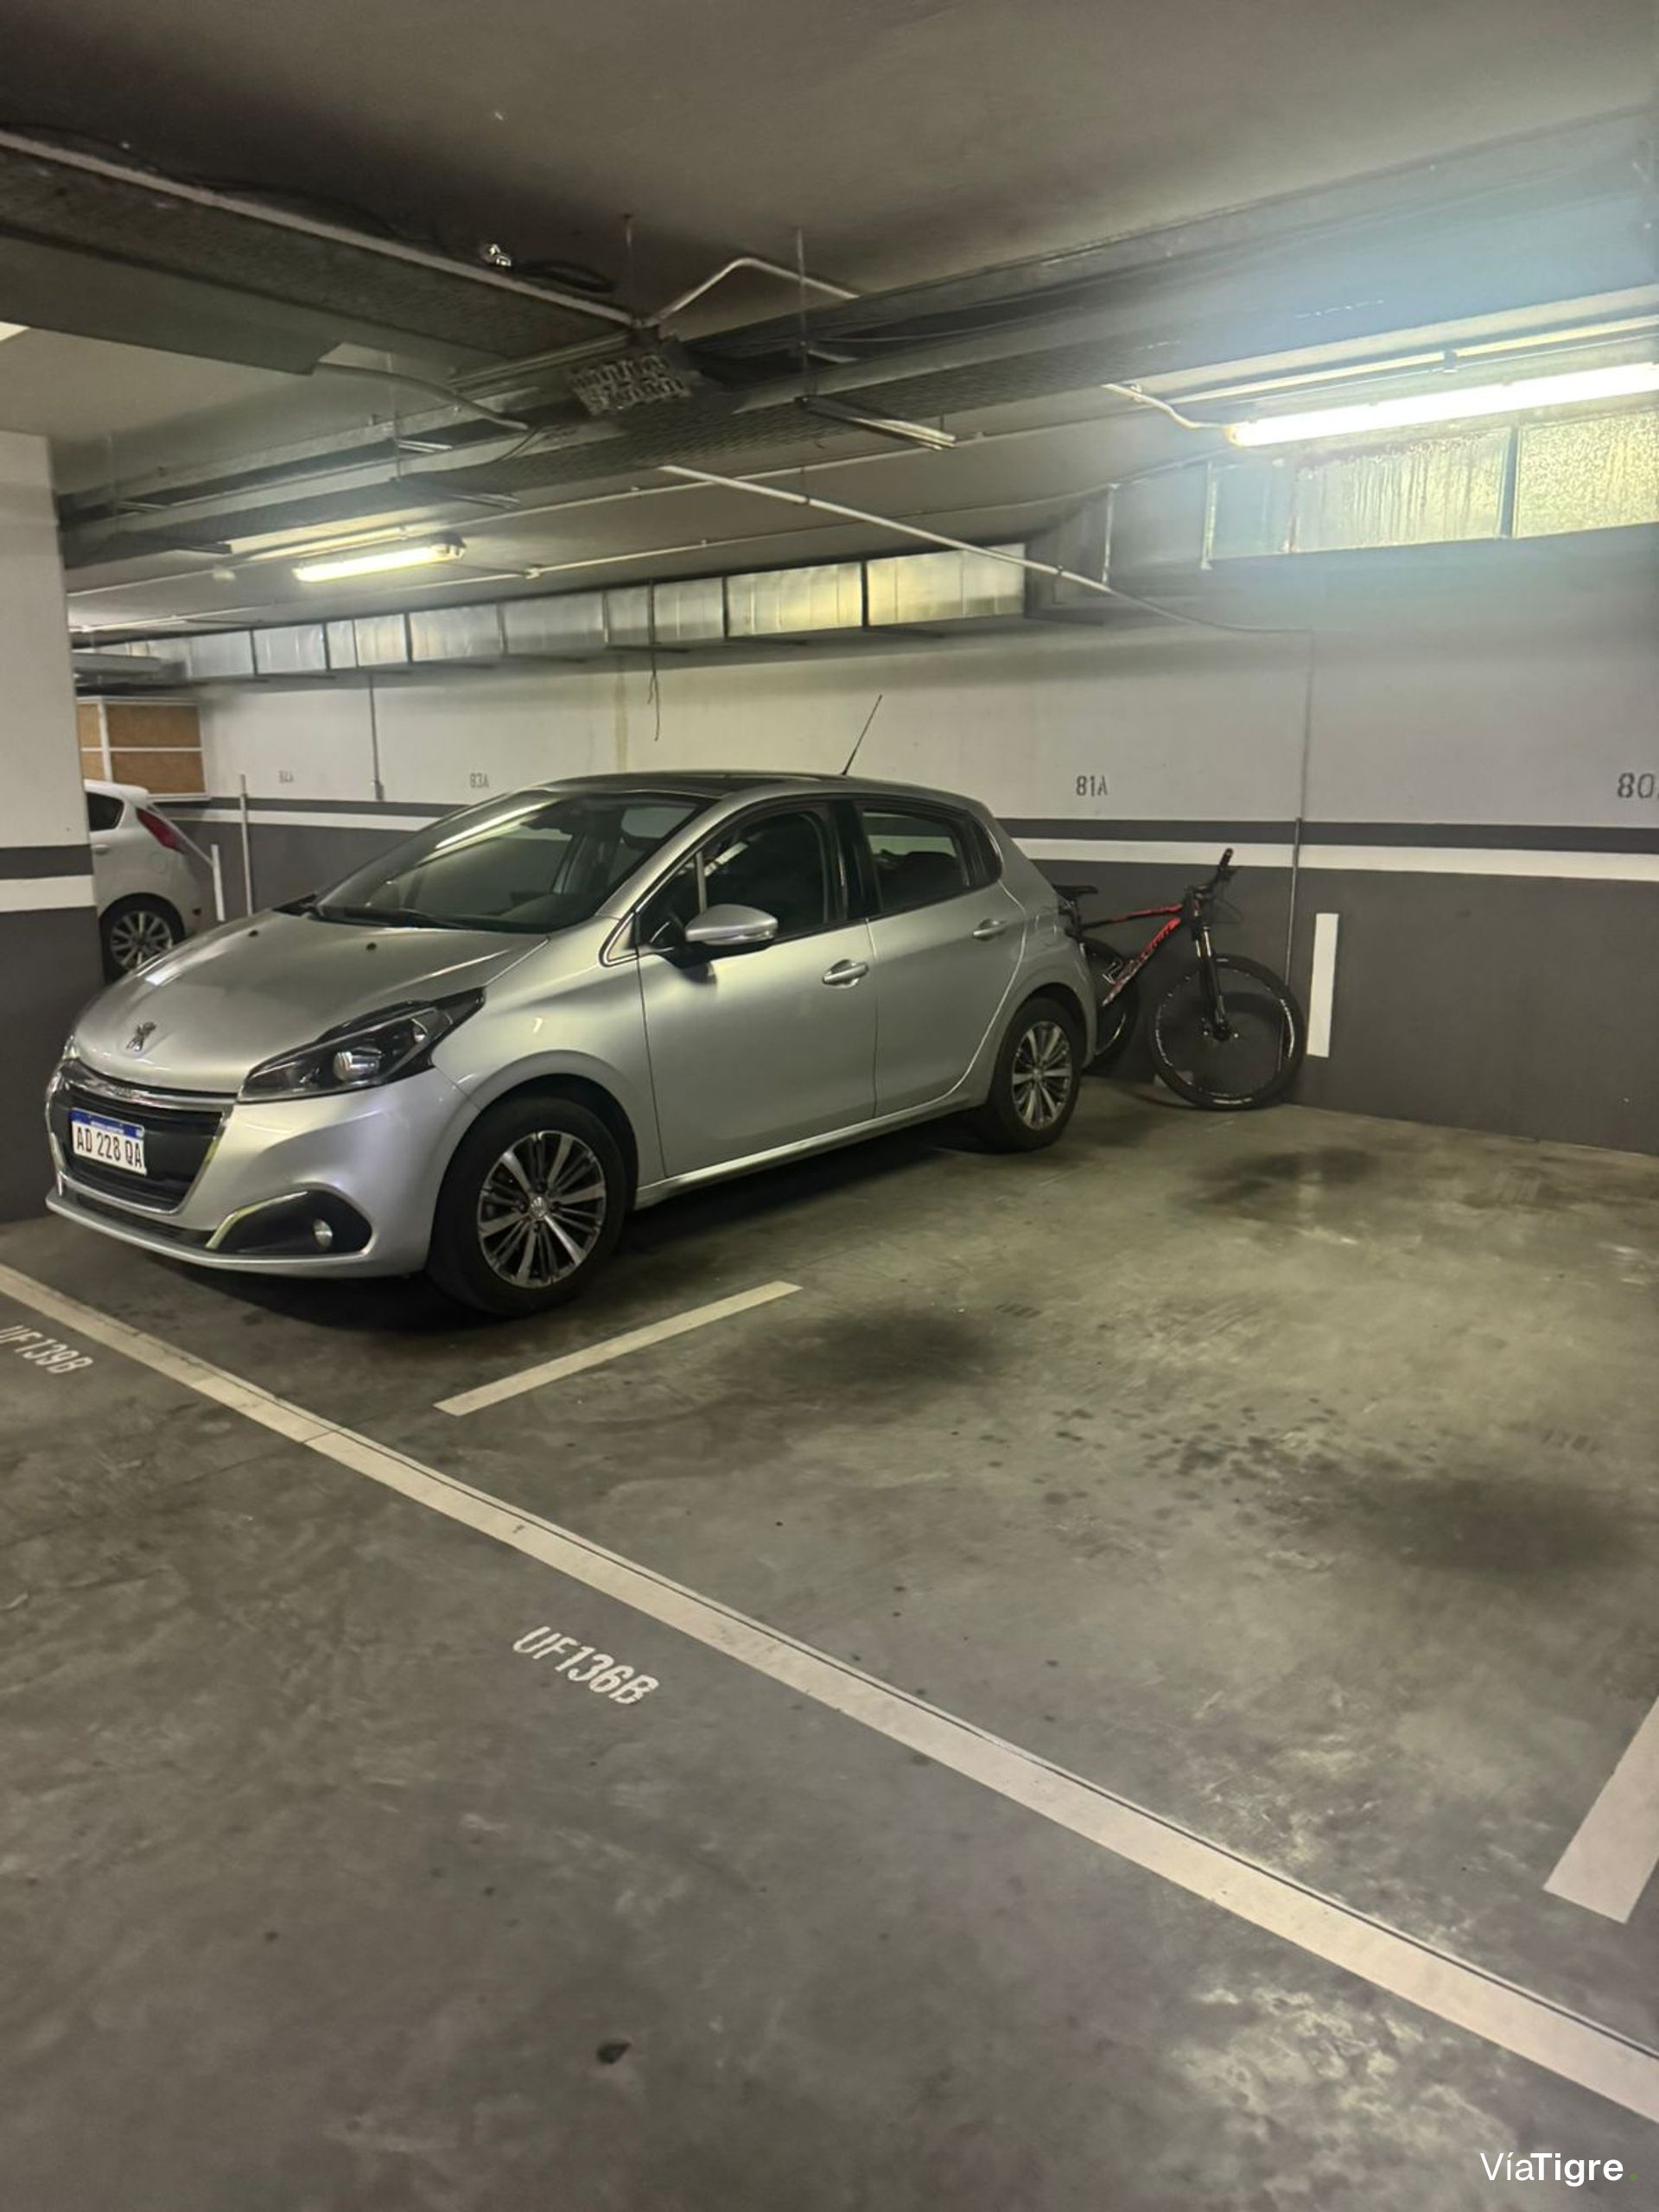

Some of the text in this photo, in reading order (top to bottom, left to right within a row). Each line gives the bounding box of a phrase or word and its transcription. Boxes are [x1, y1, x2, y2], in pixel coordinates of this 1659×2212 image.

[1076, 774, 1107, 797] 81A
[1618, 772, 1659, 798] 80
[77, 1126, 92, 1153] AD
[96, 1132, 121, 1161] 228
[124, 1141, 143, 1168] QA
[512, 1626, 659, 1704] UF136B
